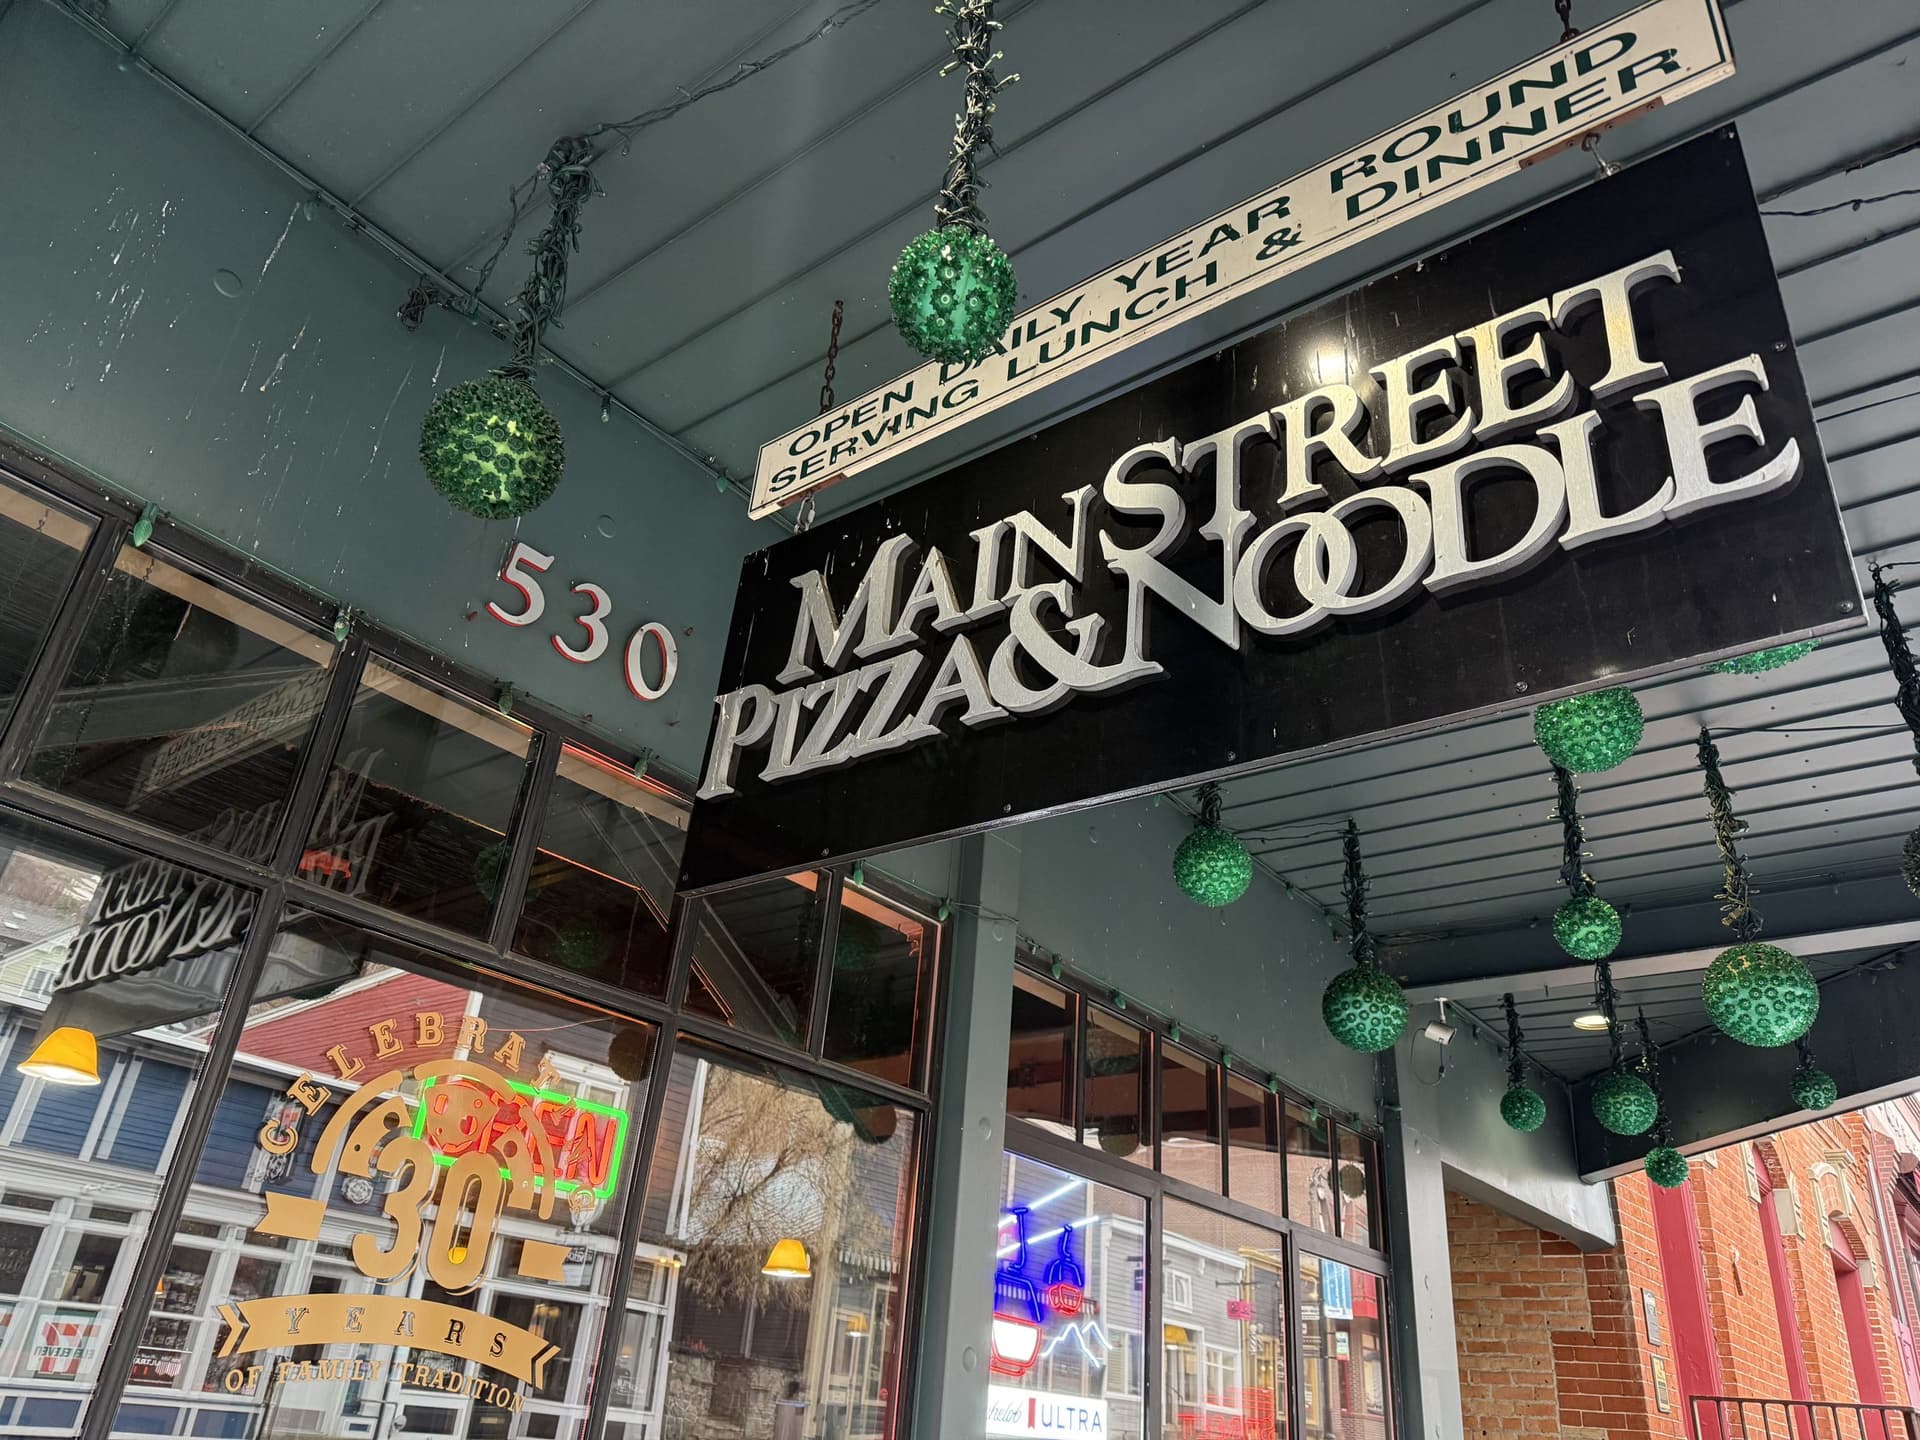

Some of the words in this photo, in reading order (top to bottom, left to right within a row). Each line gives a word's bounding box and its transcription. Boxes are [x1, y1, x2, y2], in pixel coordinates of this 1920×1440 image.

[769, 379, 979, 492] SERVING
[1007, 261, 1217, 381] LUNCH
[1256, 226, 1305, 261] &
[1346, 48, 1681, 220] DINNER
[789, 381, 914, 457] OPEN
[1113, 195, 1290, 293] YEAR
[1330, 32, 1637, 193] ROUND
[776, 484, 1097, 684] MAIN
[1099, 249, 1683, 556] STREET
[486, 543, 678, 700] 530
[696, 632, 1014, 799] PIZZA
[988, 579, 1106, 713] &
[1105, 353, 1801, 674] NOODLE
[260, 1012, 596, 1214] CELEBRATING
[427, 1080, 617, 1186] PEN
[352, 1137, 505, 1295] 30
[225, 1366, 264, 1393] OF
[278, 1359, 385, 1385] FAMILY
[401, 1362, 528, 1415] TRADITION
[285, 1307, 507, 1358] YEARS
[1041, 1403, 1103, 1433] ULTRA
